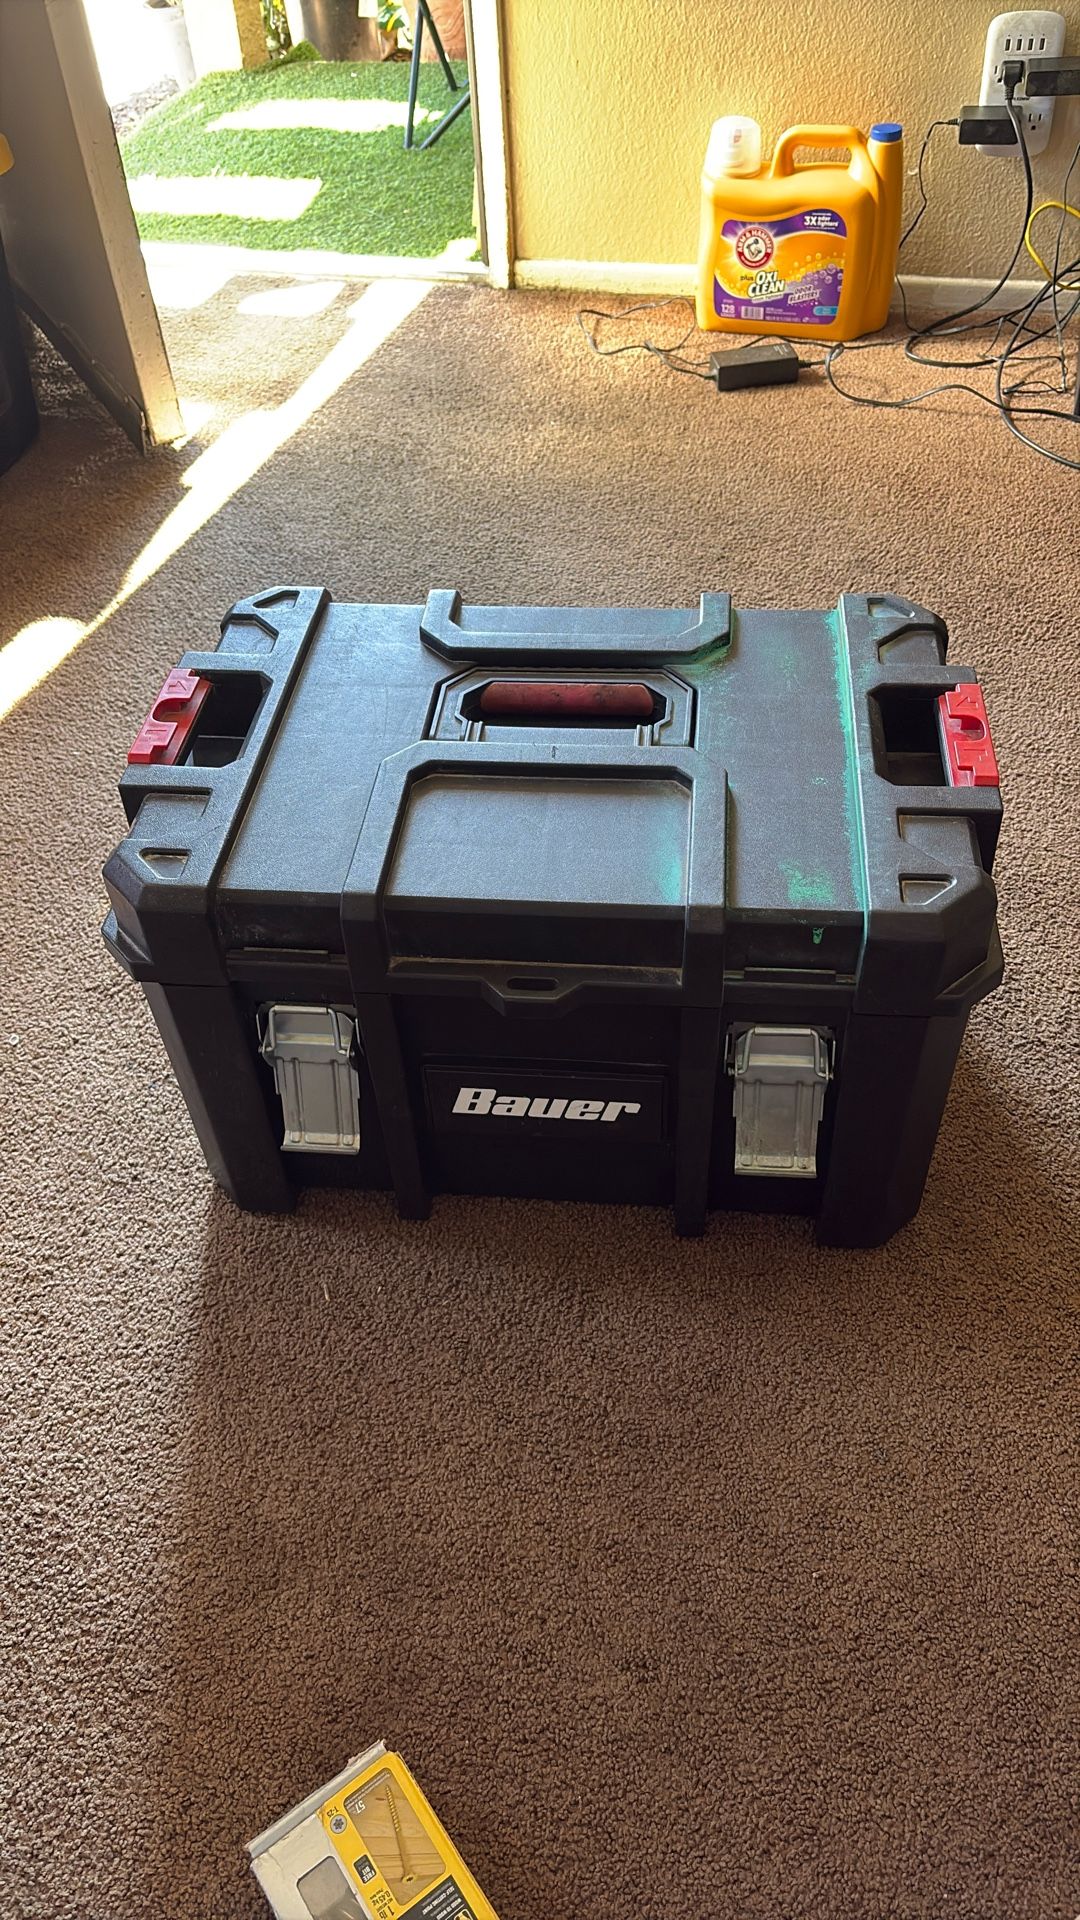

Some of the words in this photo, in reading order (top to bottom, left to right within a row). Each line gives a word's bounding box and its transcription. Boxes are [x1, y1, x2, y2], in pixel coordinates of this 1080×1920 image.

[804, 216, 817, 226] 3X
[751, 229, 773, 253] HAMMER
[755, 270, 778, 285] OXI
[748, 280, 785, 298] CLEAN
[721, 304, 735, 314] 128
[452, 1087, 641, 1122] Bauer
[355, 1800, 366, 1814] 57
[362, 1869, 376, 1883] FREE
